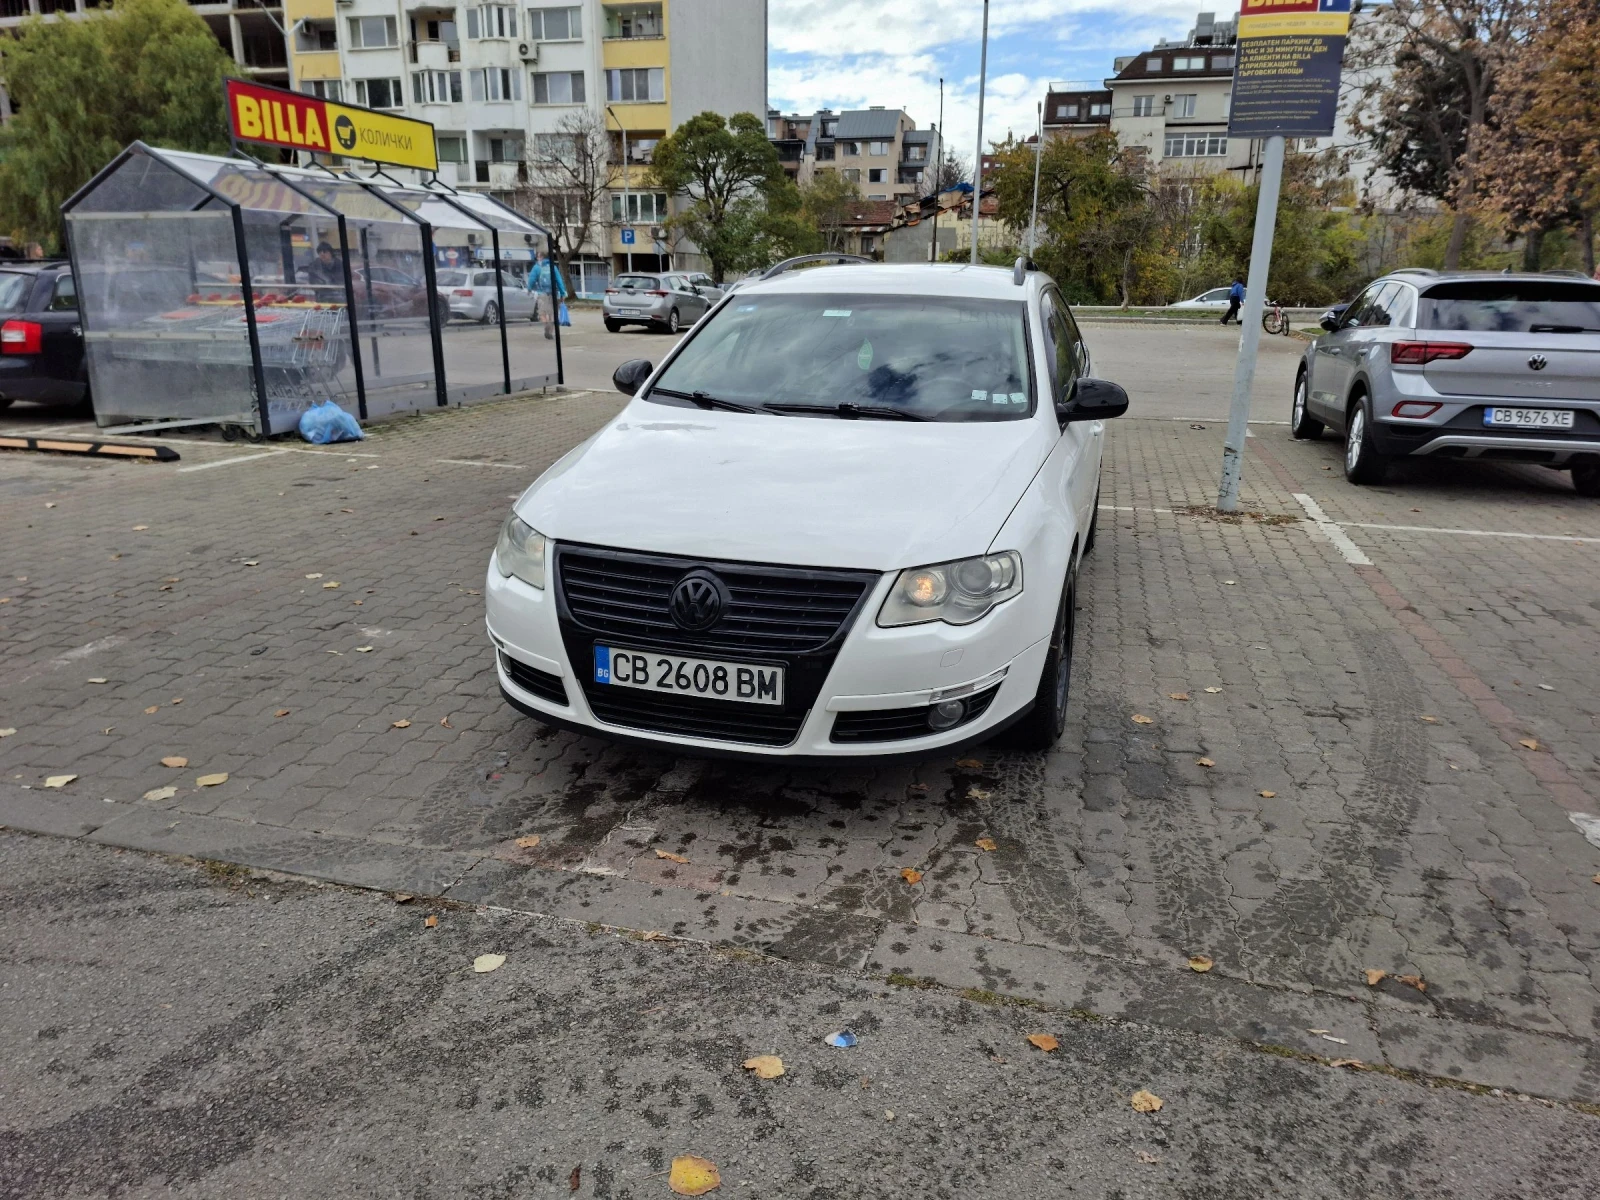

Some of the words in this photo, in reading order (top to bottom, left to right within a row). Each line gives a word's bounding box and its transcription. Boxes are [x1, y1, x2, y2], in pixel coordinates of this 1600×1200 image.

[1241, 39, 1280, 48] БЕЗПЛАТЕН
[1312, 38, 1323, 46] ДО
[1275, 45, 1303, 53] МИНУТИ
[1313, 45, 1328, 53] ДЕН
[1245, 61, 1298, 69] ПРИЛЕЖАЩИТЕ
[1239, 69, 1277, 77] ТЪРГОВСКИ
[1278, 67, 1304, 75] ПЛОЩИ
[236, 94, 326, 148] BILLA
[359, 127, 413, 151] КОЛИЧКИ
[624, 230, 632, 243] P
[1494, 409, 1512, 423] CB
[1515, 410, 1549, 424] 9676
[1552, 411, 1570, 425] XE
[597, 667, 609, 678] BG
[613, 652, 650, 685] CB
[656, 658, 729, 696] 2608
[736, 667, 778, 701] BM
